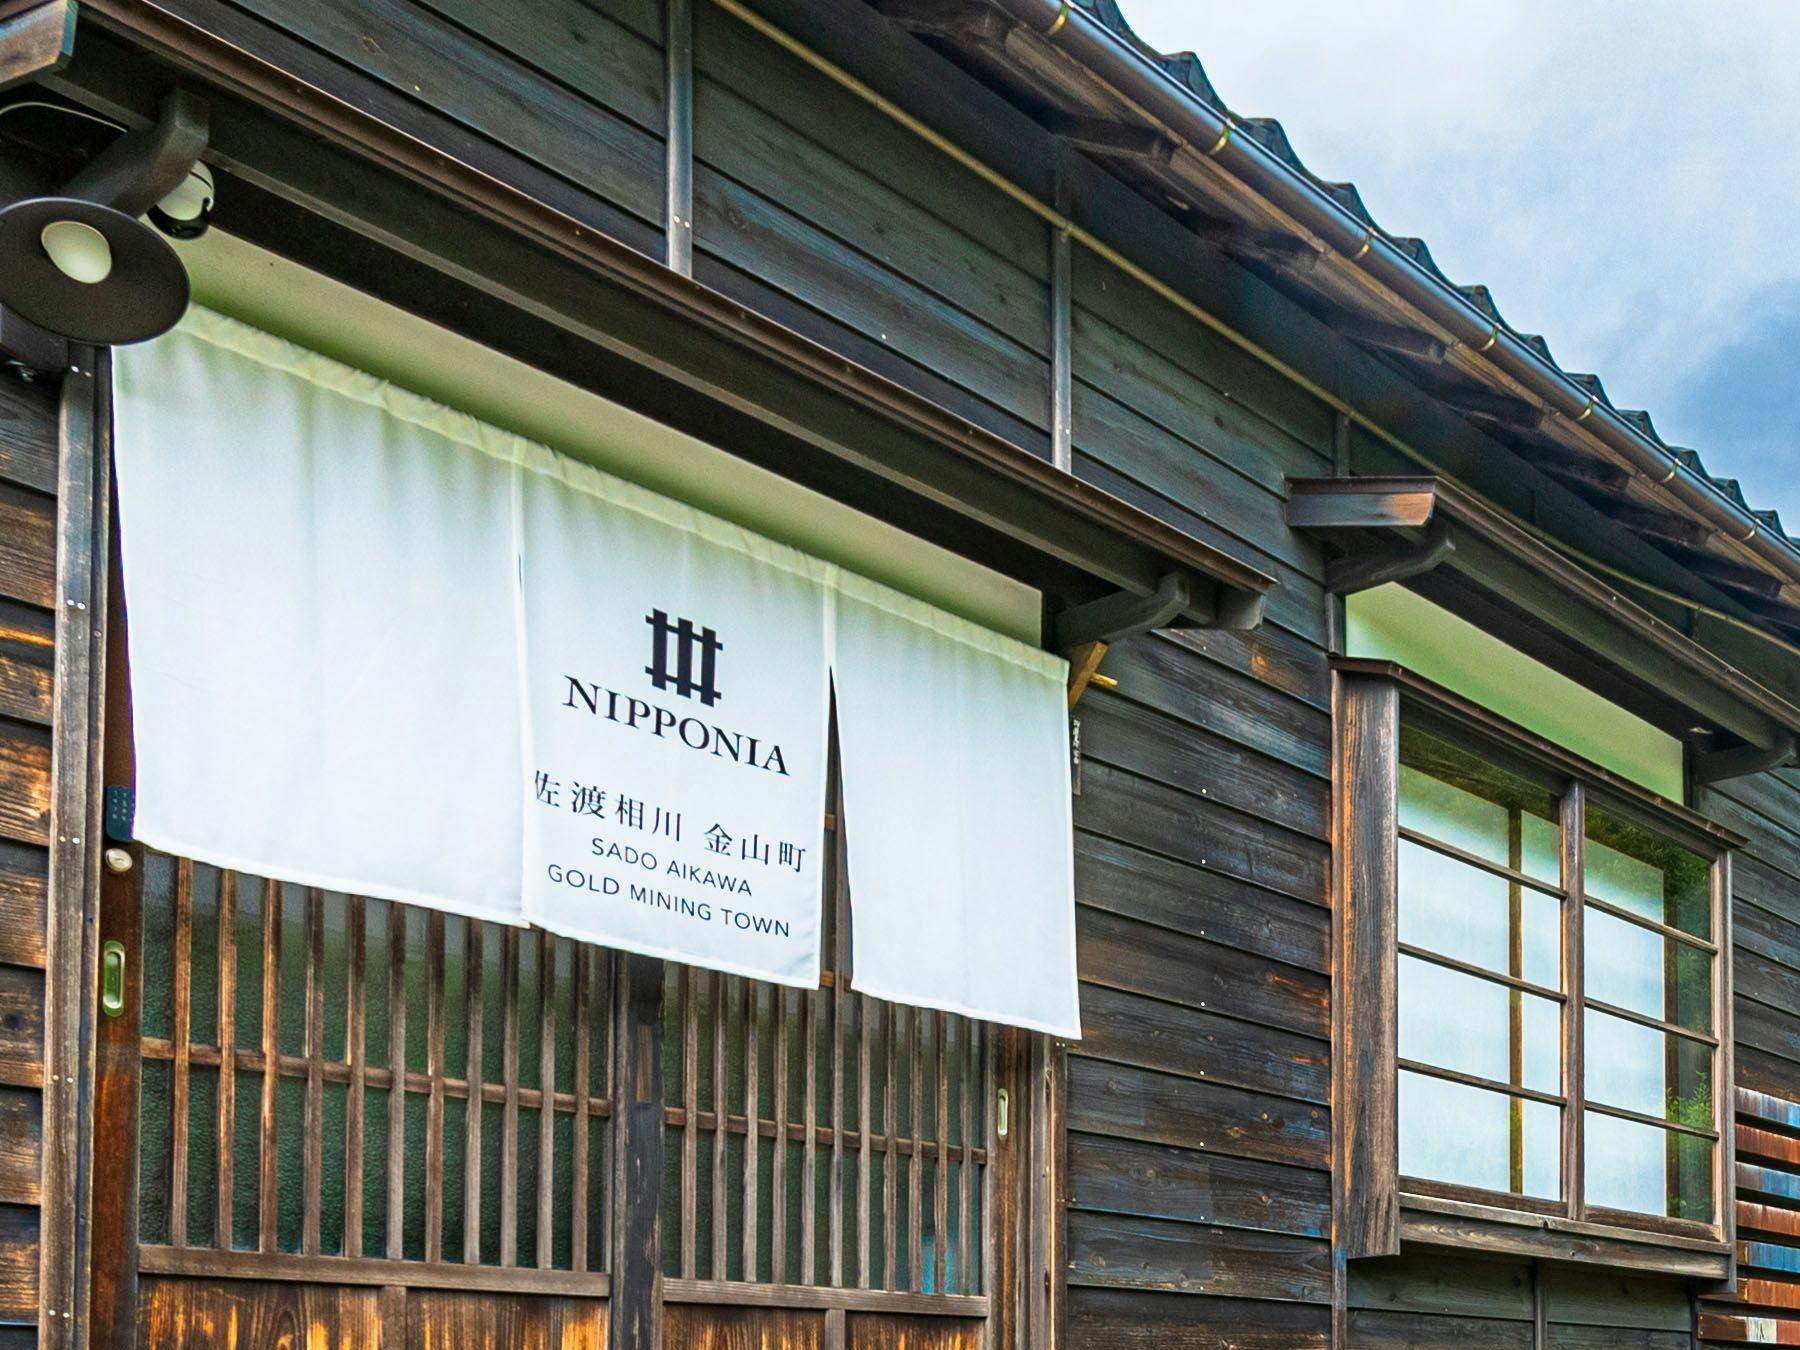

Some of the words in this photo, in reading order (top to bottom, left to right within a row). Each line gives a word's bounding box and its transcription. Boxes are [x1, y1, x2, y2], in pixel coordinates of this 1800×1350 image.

[562, 674, 791, 777] NIPPONIA
[533, 768, 682, 843] 佐渡相川
[703, 822, 807, 874] 金山町
[547, 863, 621, 896] GOLD
[629, 882, 712, 921] MINING
[720, 907, 789, 938] TOWN
[591, 837, 659, 871] SADO
[666, 859, 754, 897] AIKAWA
